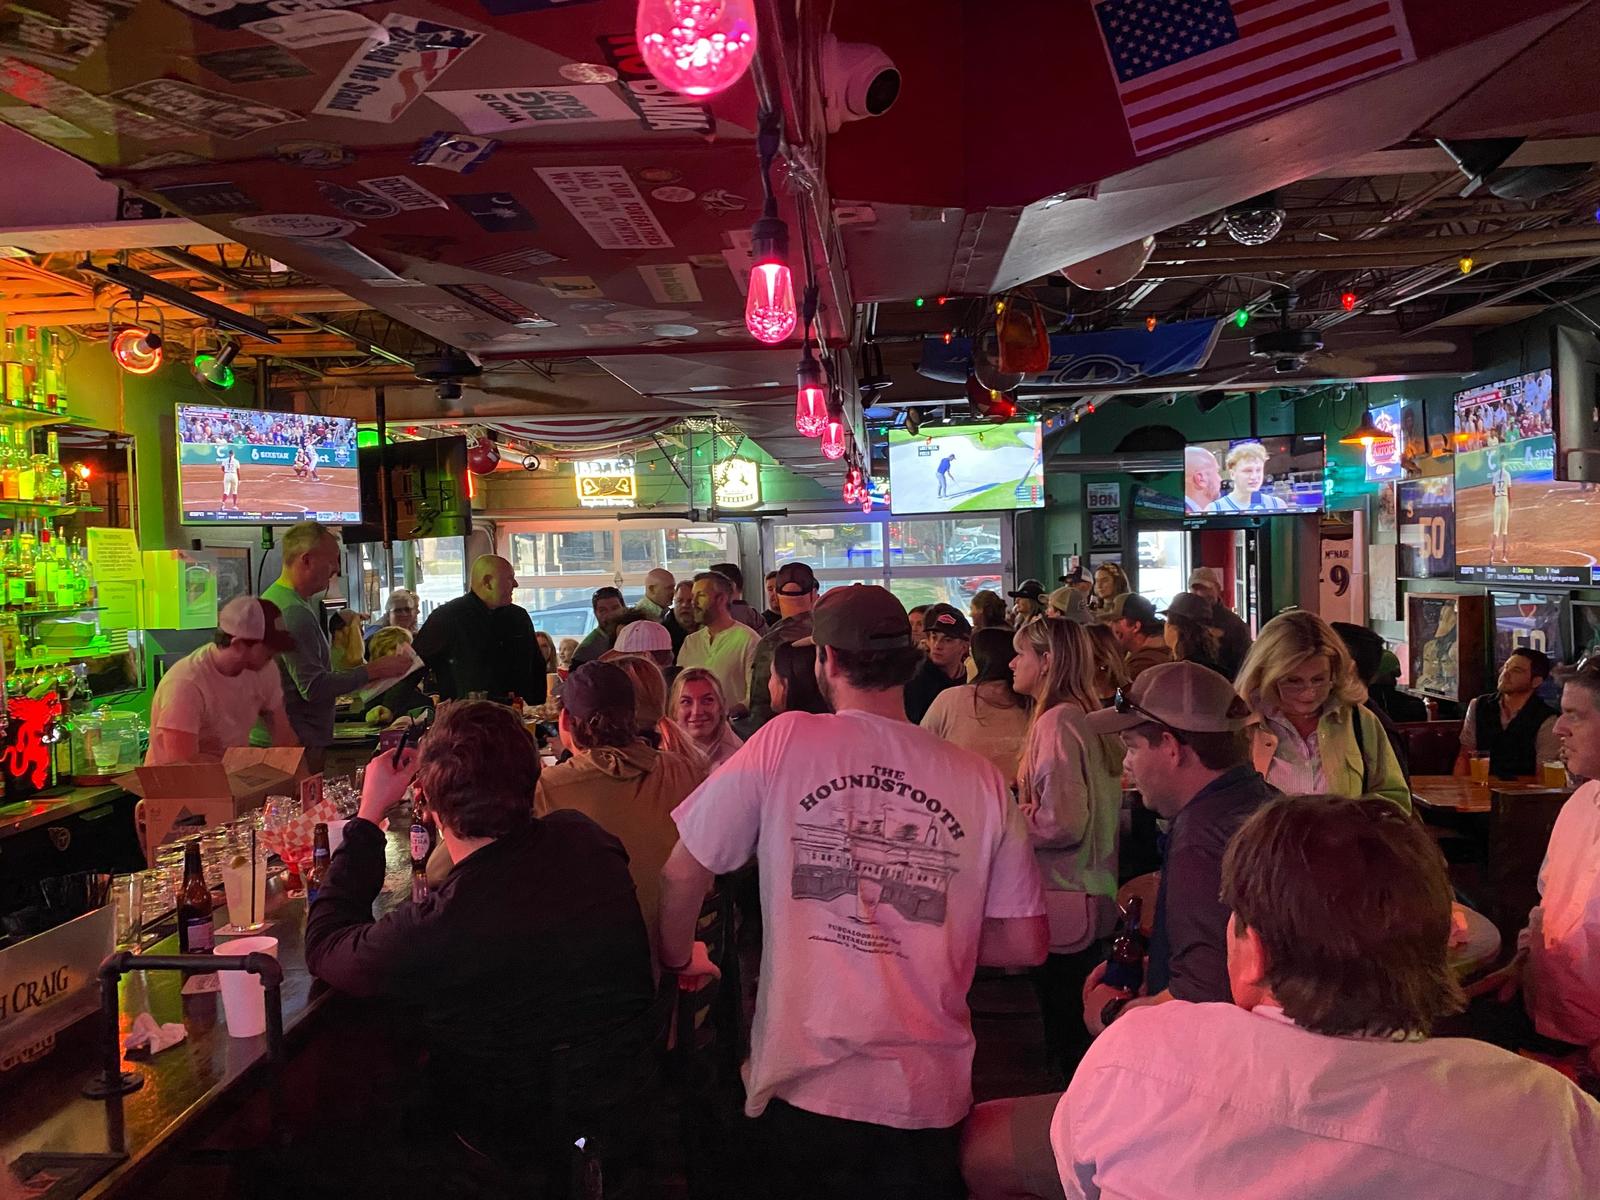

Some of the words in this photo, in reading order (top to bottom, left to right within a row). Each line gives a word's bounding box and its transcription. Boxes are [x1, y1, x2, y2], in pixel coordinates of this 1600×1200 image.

[347, 63, 397, 83] We
[325, 82, 381, 111] Stand
[502, 91, 566, 121] BIG
[485, 102, 522, 123] WHO
[548, 172, 581, 193] WE'D
[566, 195, 594, 208] ALL
[573, 171, 604, 189] HAD
[591, 196, 620, 211] GUN
[606, 182, 636, 198] OUR
[620, 202, 666, 245] FOREFATHERS
[1330, 565, 1350, 597] 9
[871, 765, 905, 781] THE
[800, 775, 965, 841] HOUNDSTOOTH
[12, 966, 69, 1013] CRAIG
